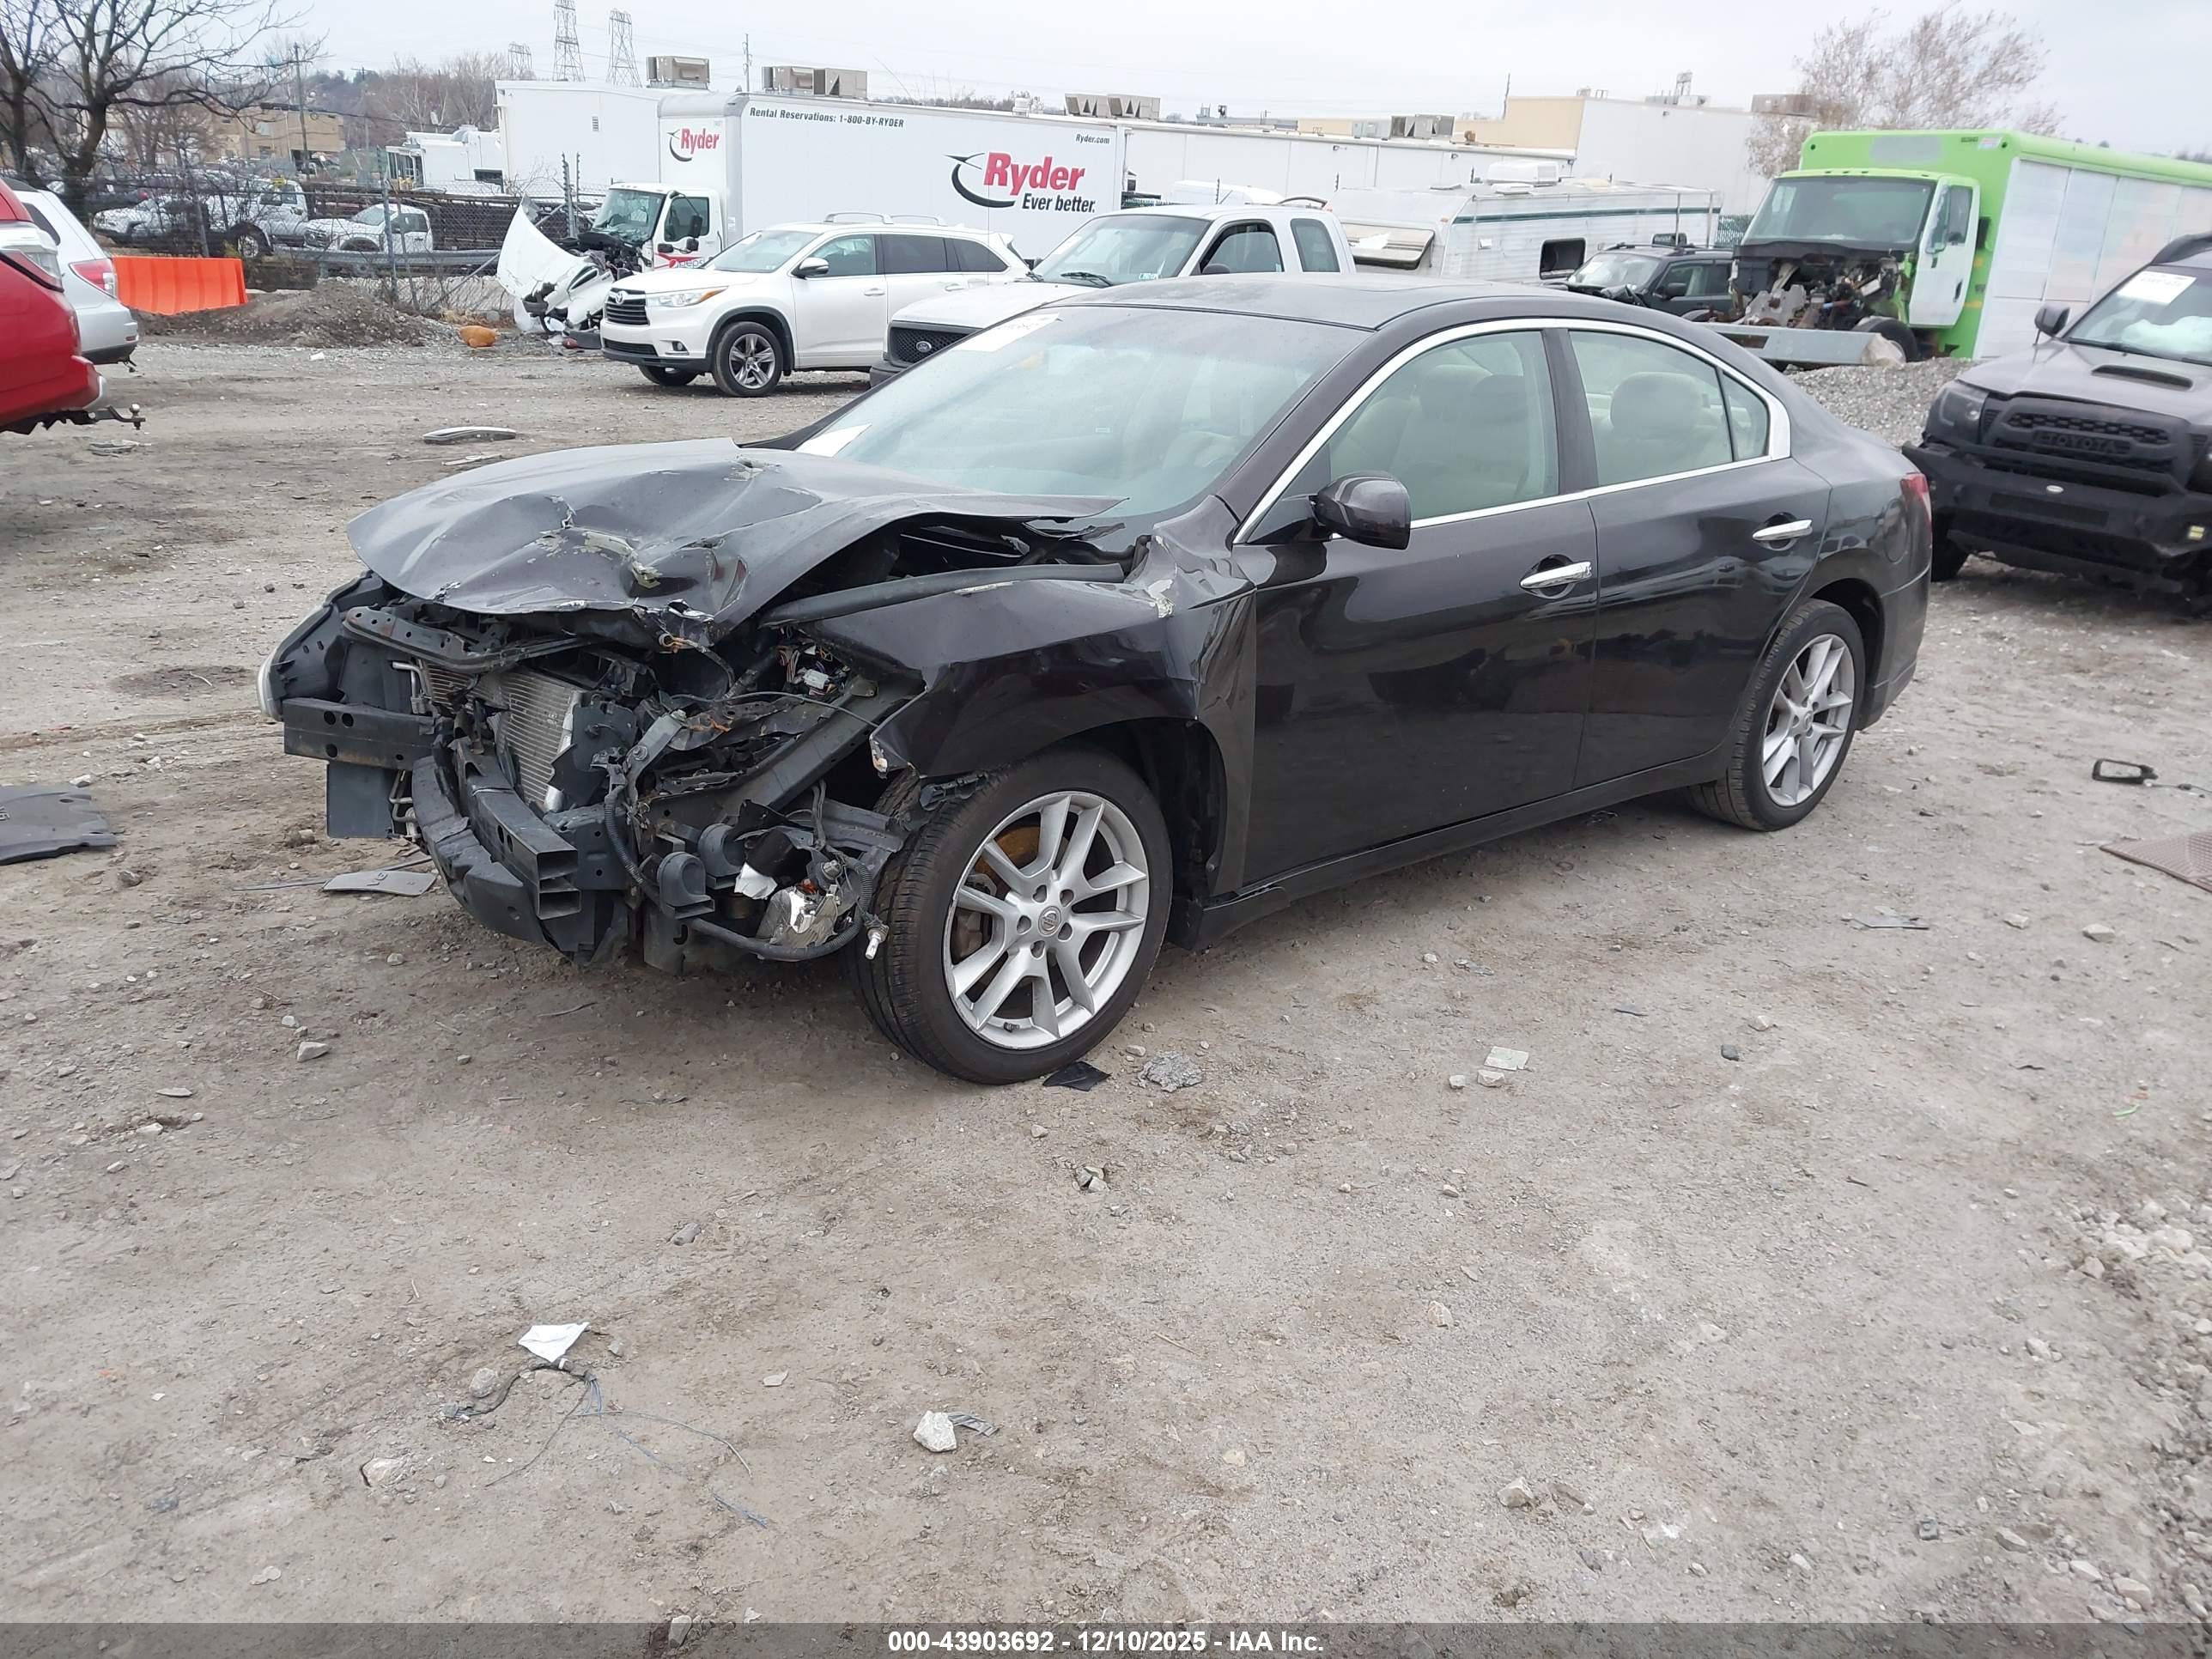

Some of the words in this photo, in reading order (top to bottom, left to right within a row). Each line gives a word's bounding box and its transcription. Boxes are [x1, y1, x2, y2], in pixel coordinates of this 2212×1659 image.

[750, 107, 777, 118] Rental
[780, 110, 836, 123] Reservations:
[839, 114, 904, 128] 1-800-BY-RYDER
[681, 128, 720, 155] Ryder
[1075, 134, 1110, 144] Ryder.com
[983, 151, 1086, 197] Ryder
[1022, 192, 1054, 210] Ever
[1054, 195, 1096, 213] better.
